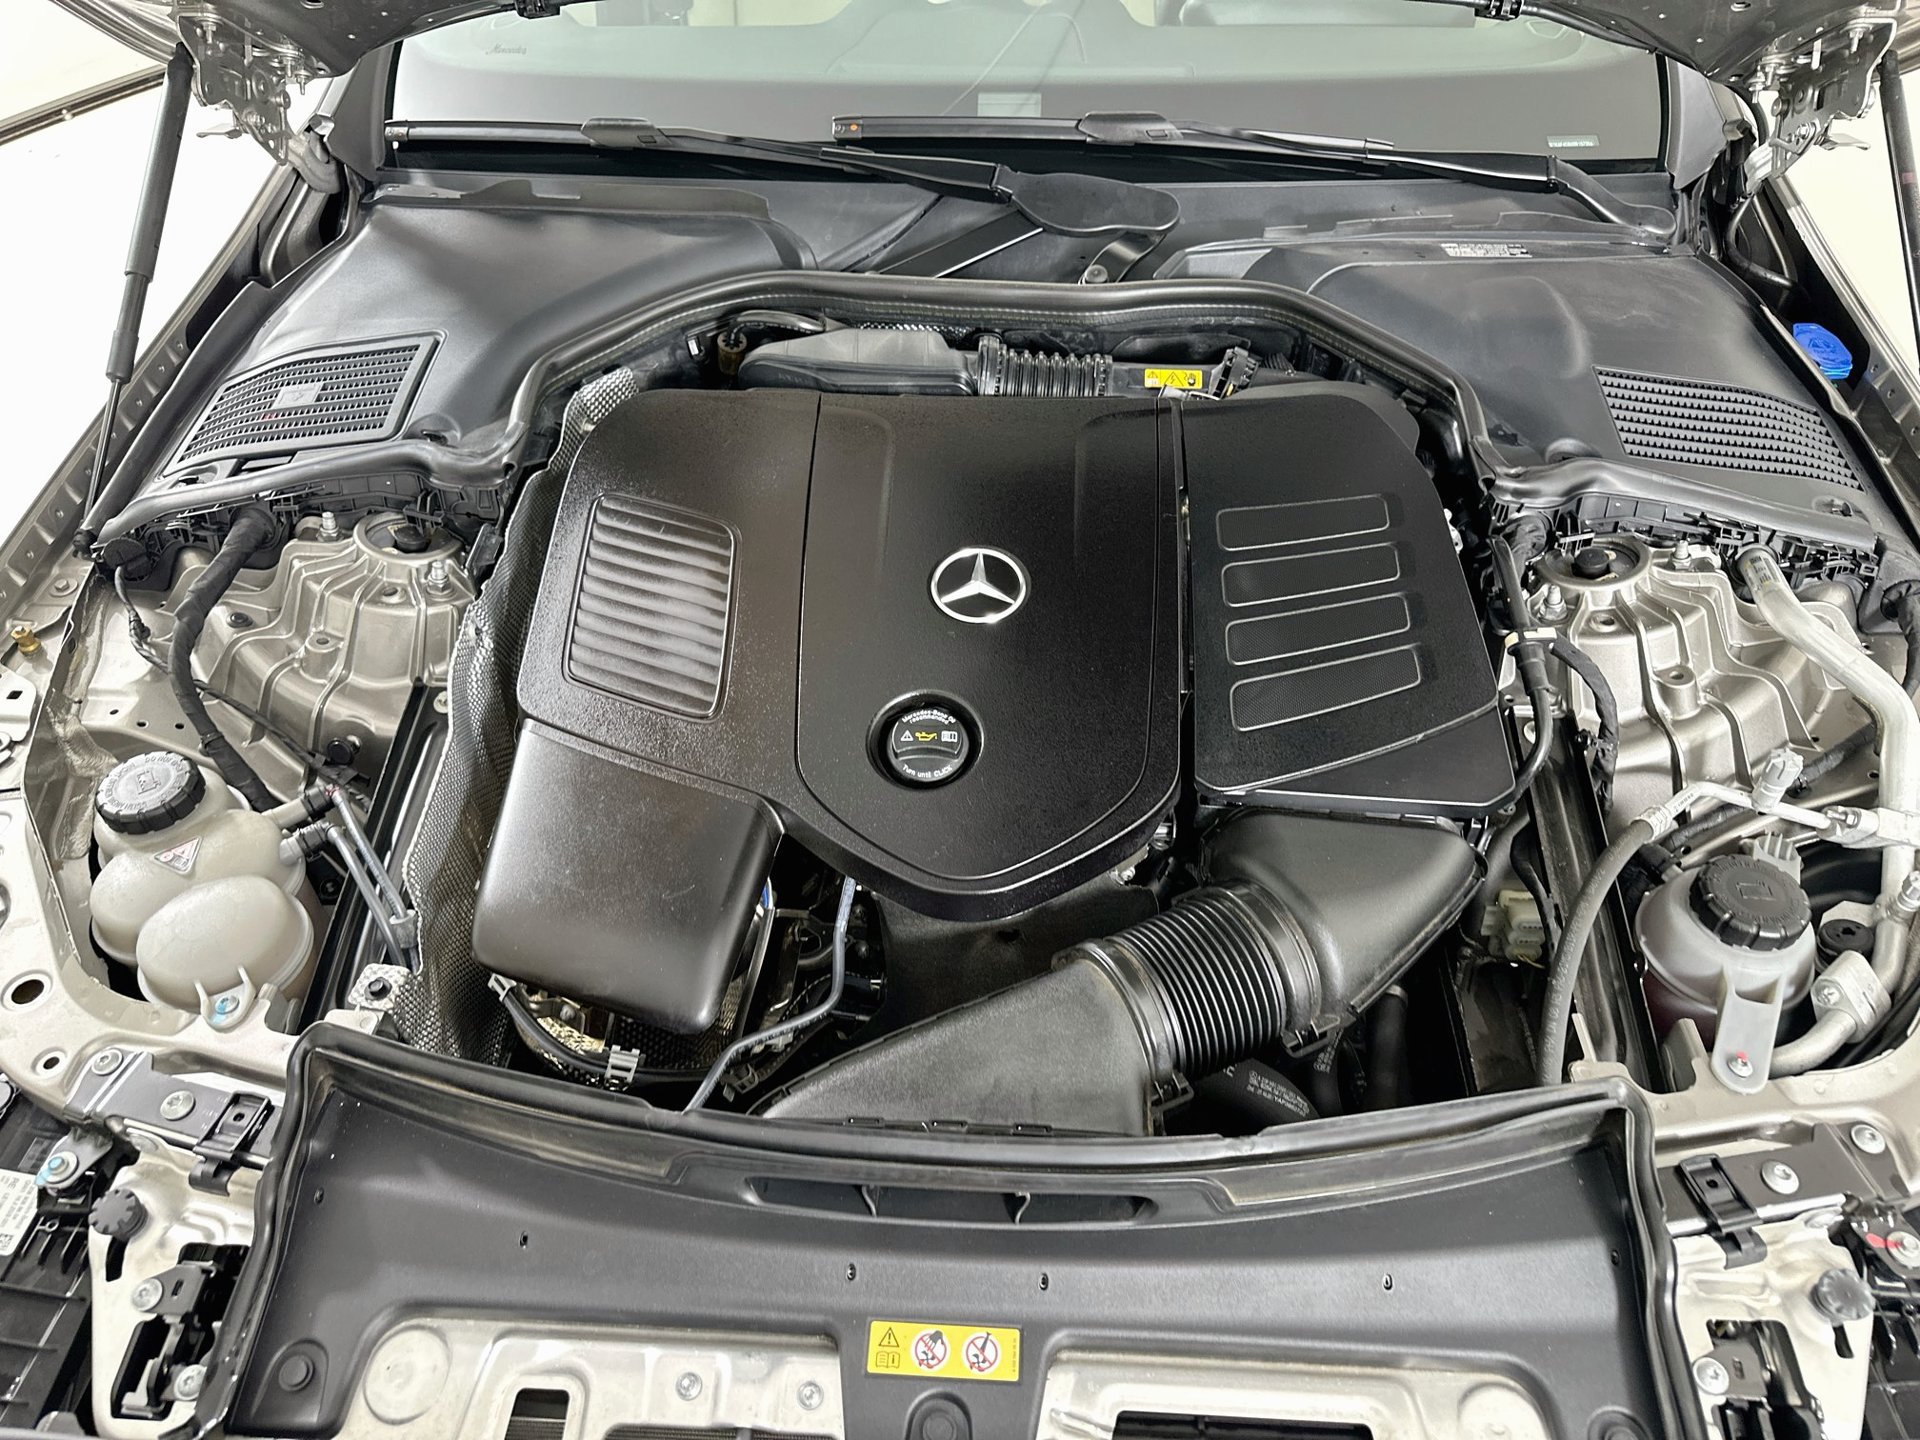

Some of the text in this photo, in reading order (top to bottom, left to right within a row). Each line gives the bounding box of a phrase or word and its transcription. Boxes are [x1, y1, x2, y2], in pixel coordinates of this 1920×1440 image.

[902, 709, 948, 723] Mercedes-Benz
[910, 715, 949, 724] recommended
[903, 764, 916, 776] Turn
[933, 765, 953, 777] CLICK
